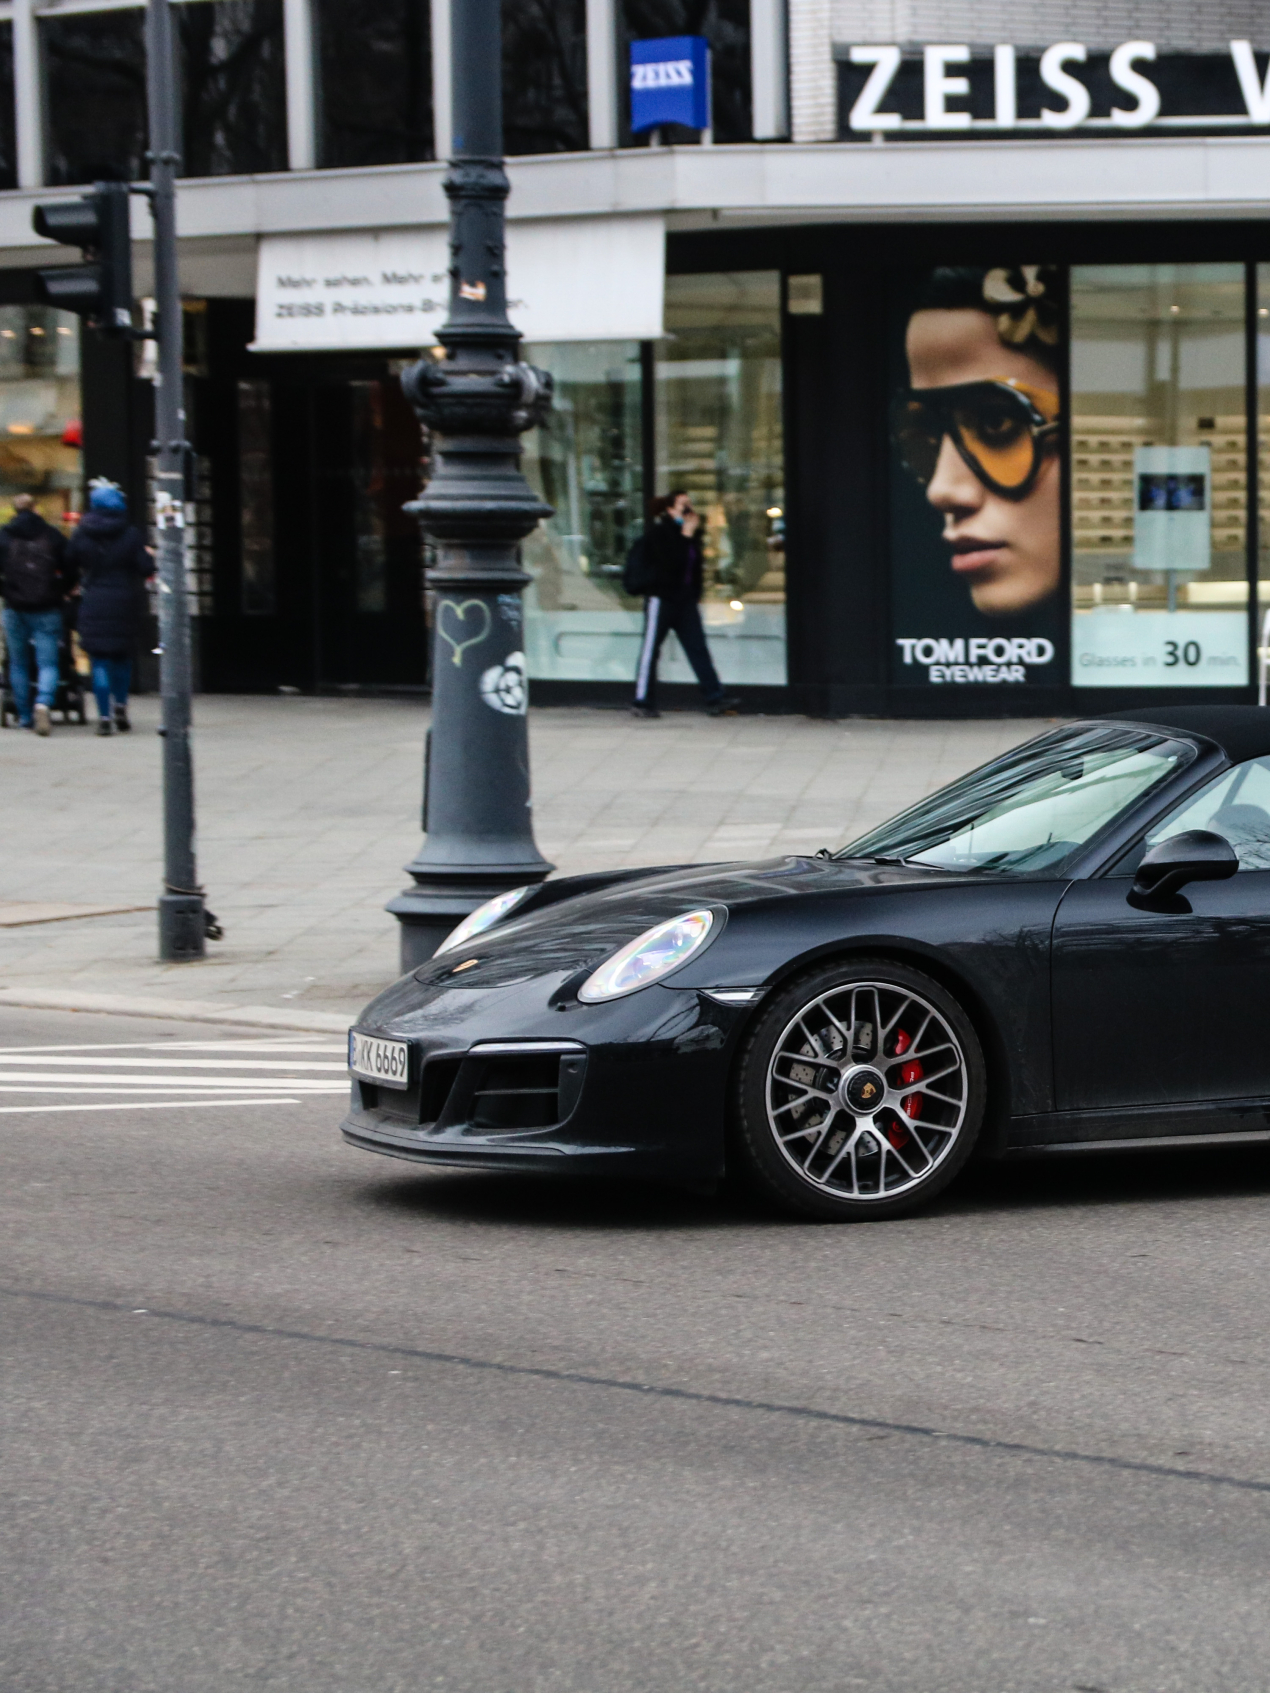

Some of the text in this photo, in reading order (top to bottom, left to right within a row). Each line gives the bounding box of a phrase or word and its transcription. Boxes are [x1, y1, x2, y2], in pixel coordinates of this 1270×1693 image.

[631, 60, 694, 88] ZEISS
[850, 41, 1161, 130] ZEISS
[897, 638, 1054, 664] TOM FORD
[1163, 640, 1201, 667] 30
[929, 665, 1026, 683] EYEWEAR
[375, 1043, 406, 1077] 6669
